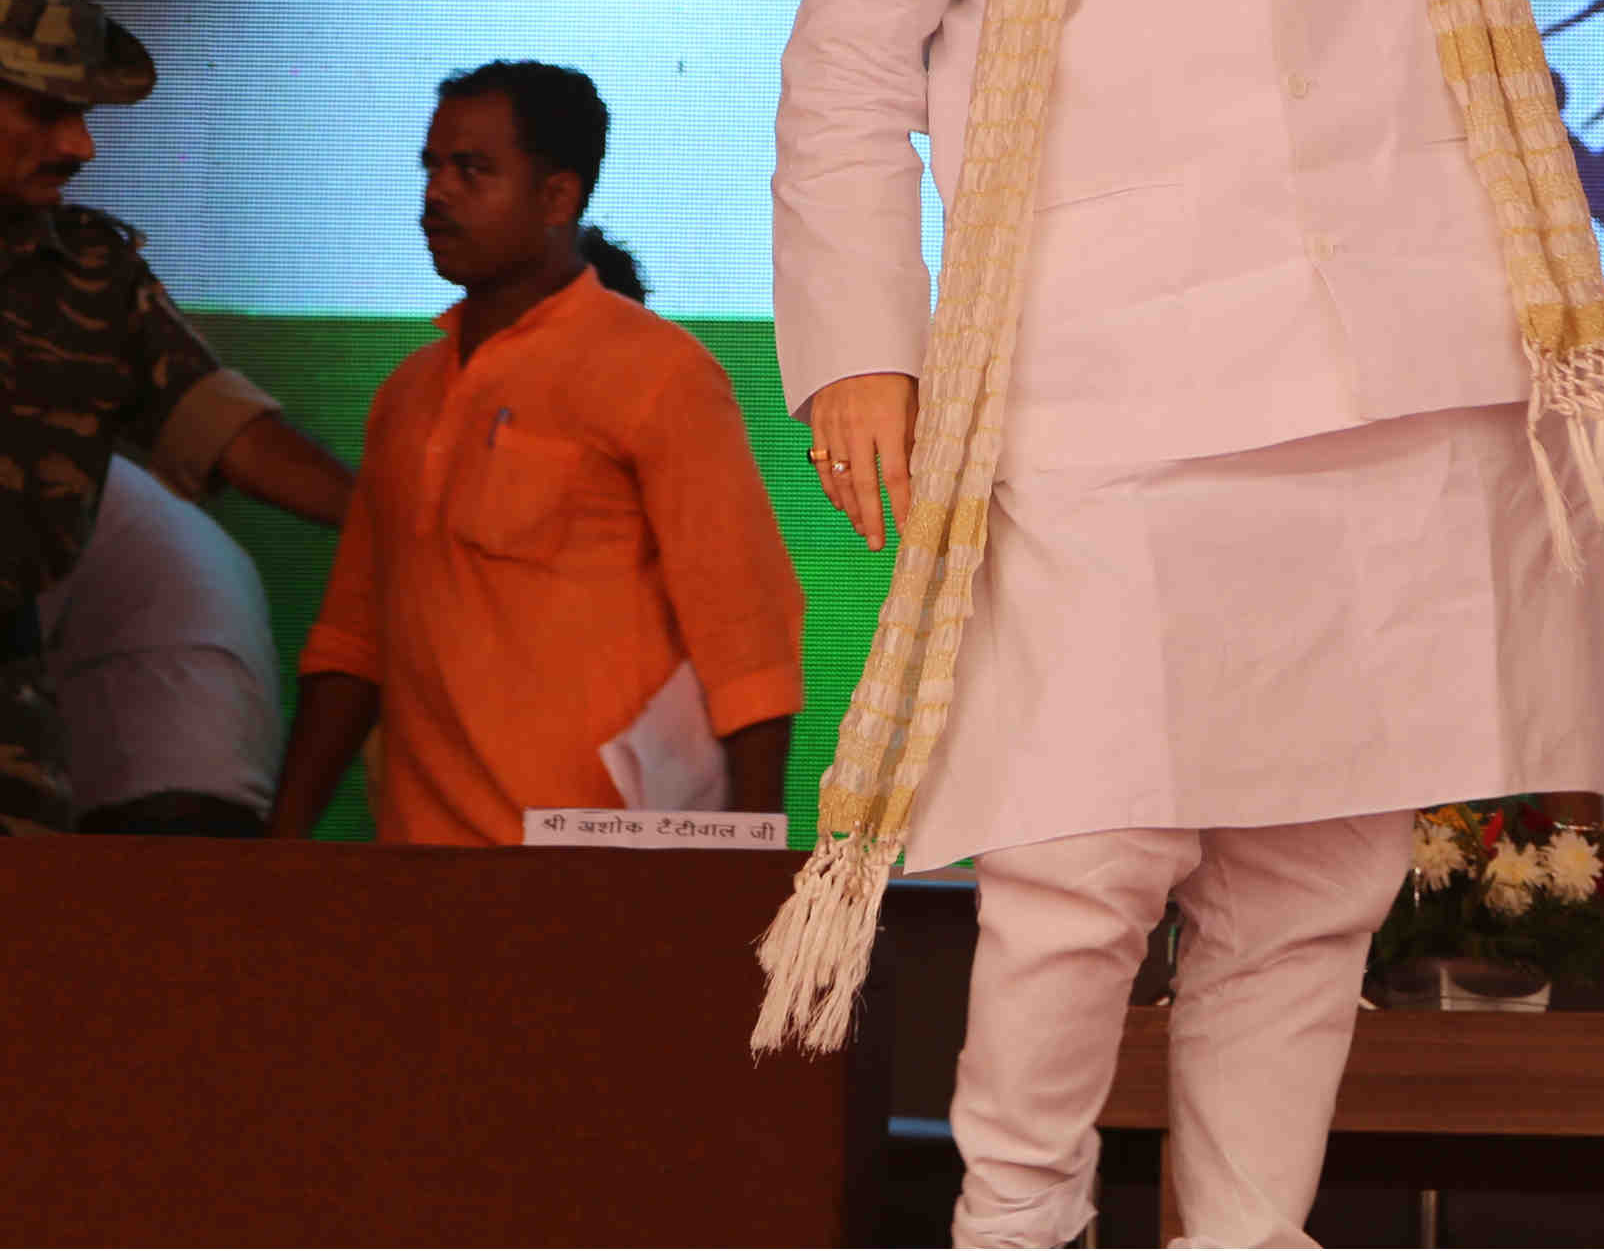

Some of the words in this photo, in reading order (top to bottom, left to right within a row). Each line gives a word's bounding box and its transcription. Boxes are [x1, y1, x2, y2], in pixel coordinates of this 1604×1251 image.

[543, 814, 565, 831] श्री
[577, 816, 644, 834] अशोक
[750, 821, 775, 841] जी
